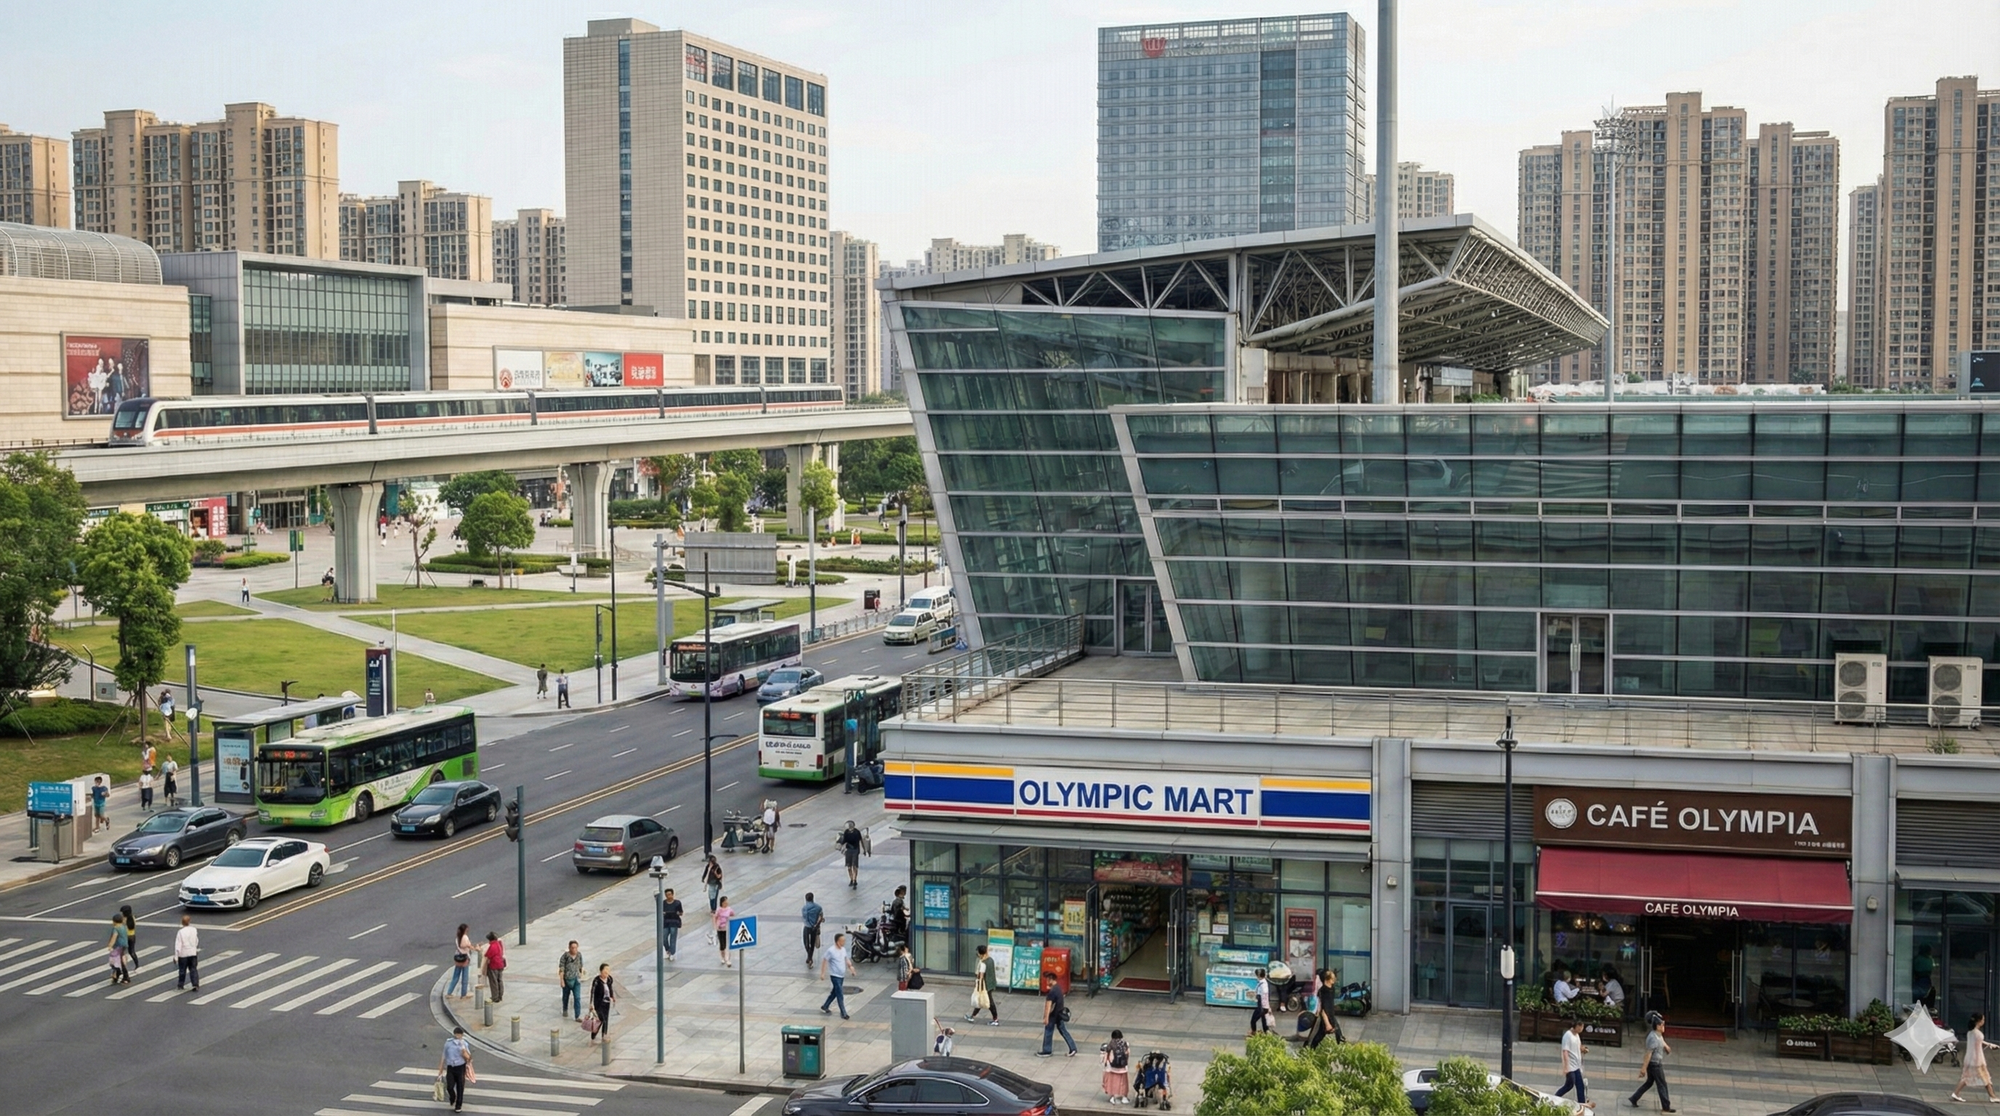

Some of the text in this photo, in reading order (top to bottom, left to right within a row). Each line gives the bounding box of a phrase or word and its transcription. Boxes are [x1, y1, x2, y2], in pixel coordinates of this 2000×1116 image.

[1019, 780, 1254, 815] OLYMPIC MART
[1586, 801, 1820, 836] CAFÉ OLYMPIA
[1645, 902, 1739, 917] CAFE OLYMPIA
